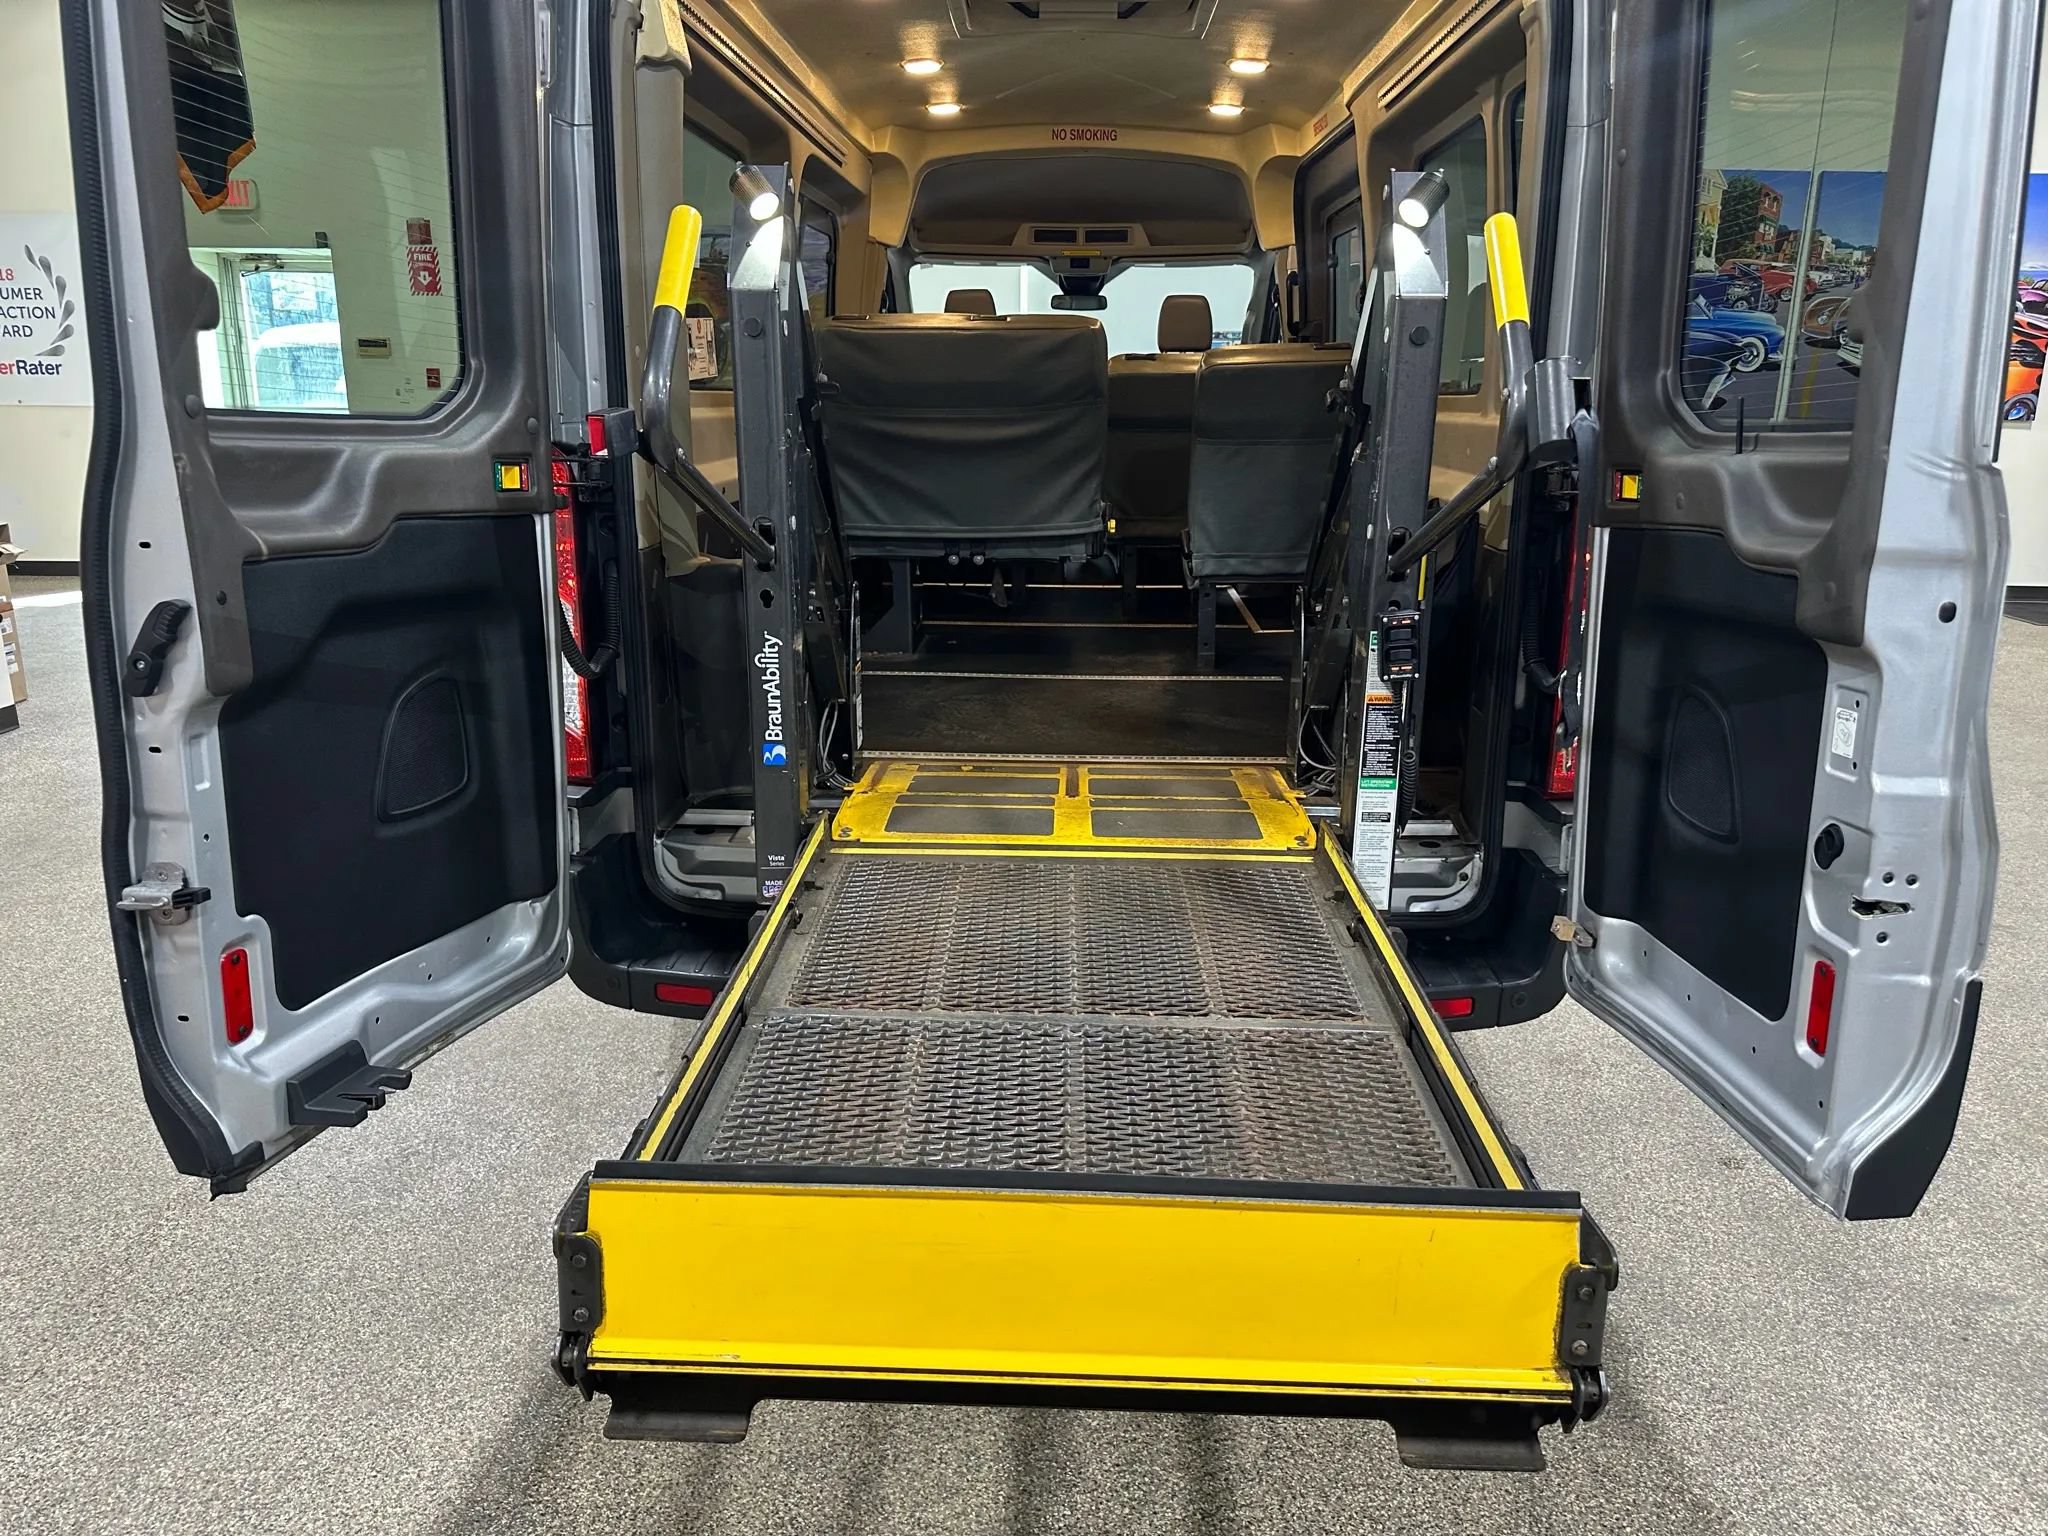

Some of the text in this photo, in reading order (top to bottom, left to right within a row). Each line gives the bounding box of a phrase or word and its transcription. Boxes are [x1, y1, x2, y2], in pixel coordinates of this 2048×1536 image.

[1052, 128, 1118, 142] NO SMOKING
[223, 180, 250, 207] XIT
[413, 253, 433, 261] FIRE
[0, 268, 14, 281] 18
[0, 287, 44, 300] UMER
[0, 306, 56, 319] ACTION
[0, 325, 33, 337] ARD
[0, 359, 62, 375] erRater
[754, 630, 784, 741] BraunAbility
